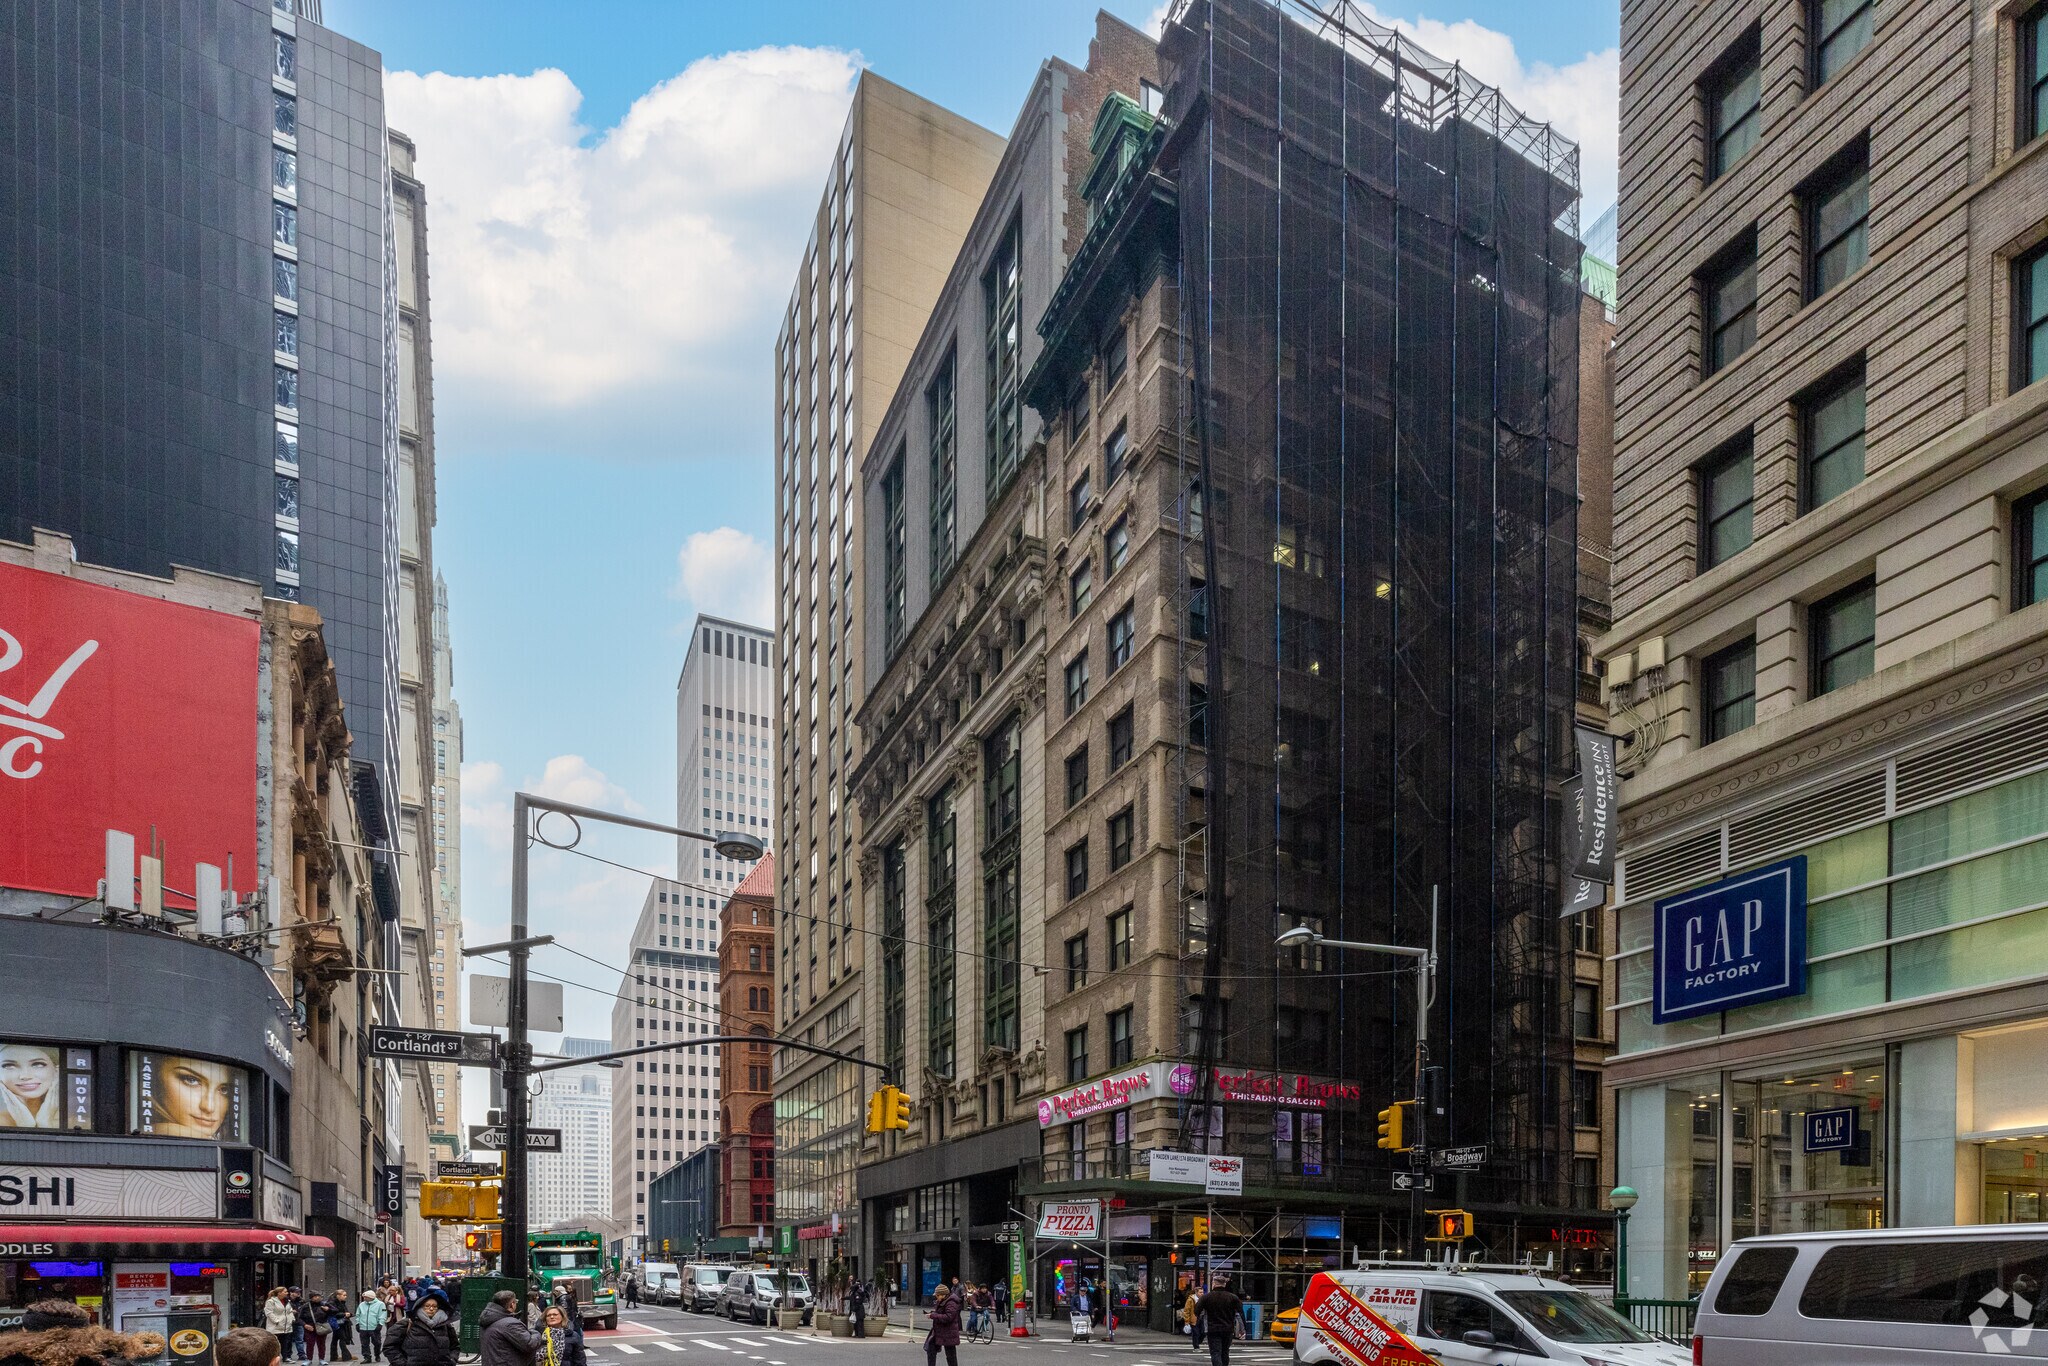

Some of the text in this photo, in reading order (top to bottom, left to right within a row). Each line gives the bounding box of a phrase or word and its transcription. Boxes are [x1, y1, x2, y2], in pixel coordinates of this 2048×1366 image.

[1602, 744, 1614, 800] BY MARRIOTT
[1587, 740, 1607, 866] Residence INN
[1685, 899, 1763, 972] GAP
[1684, 961, 1762, 990] FACTORY
[377, 1036, 459, 1054] Cortlandt ST
[75, 1058, 88, 1123] RMOVAL
[142, 1056, 153, 1133] LASER HAIR
[1052, 1085, 1098, 1115] Perfect
[1101, 1071, 1151, 1100] Brows
[1070, 1103, 1102, 1118] THREADING
[1815, 1116, 1843, 1138] GAP
[1447, 1152, 1484, 1162] Broadway
[441, 1166, 473, 1174] Cortlandt
[0, 1175, 75, 1206] SHI
[226, 1187, 252, 1195] bento
[387, 1171, 399, 1211] ALDO
[1056, 1205, 1091, 1215] PRONTO
[1043, 1215, 1095, 1231] PIZZA
[262, 1243, 298, 1255] SUSHI
[1368, 1295, 1418, 1305] SERVICE
[1373, 1287, 1416, 1297] 24 HR
[1324, 1288, 1392, 1350] FIRST RESPONSE
[1313, 1303, 1380, 1362] EXTERMINATING
